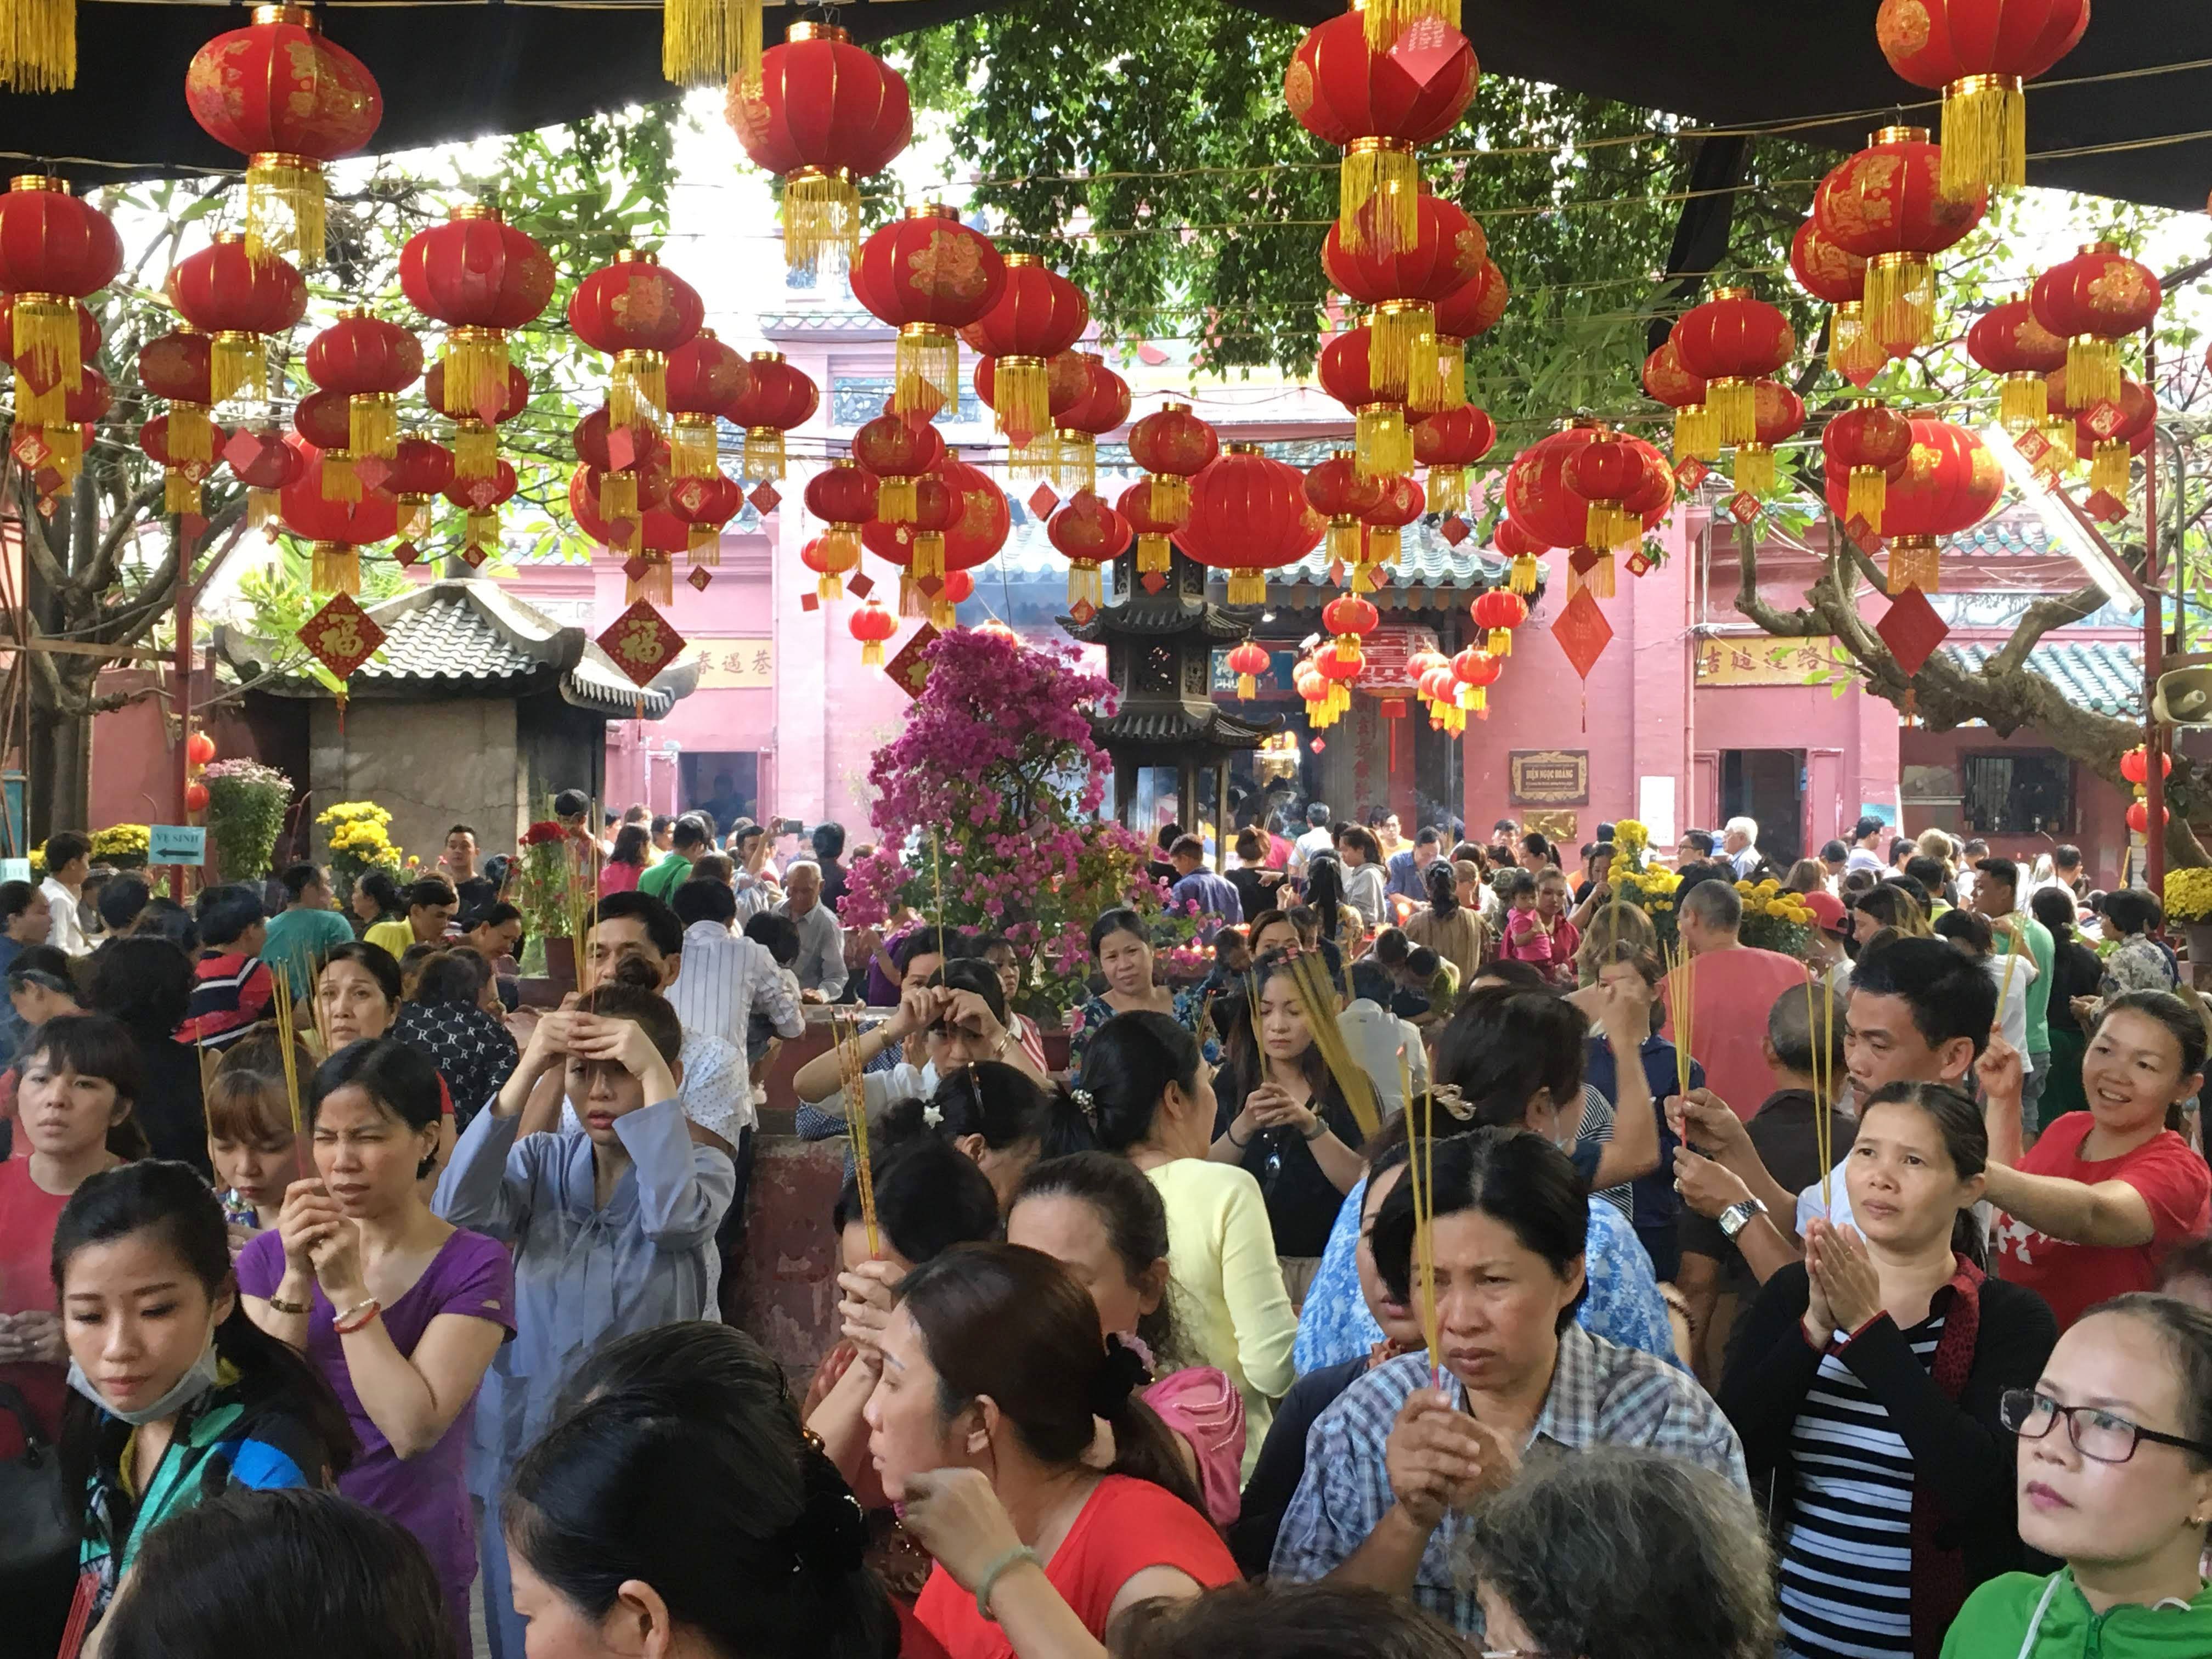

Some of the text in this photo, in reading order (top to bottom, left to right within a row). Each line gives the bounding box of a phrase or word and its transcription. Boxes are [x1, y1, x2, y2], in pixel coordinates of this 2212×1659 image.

[319, 613, 364, 657] 福
[619, 619, 664, 664] 福
[173, 834, 198, 843] SINH
[422, 1008, 433, 1018] R
[454, 1012, 464, 1023] R
[406, 1019, 414, 1028] R
[417, 1029, 428, 1041] R
[467, 1026, 476, 1036] R
[447, 1034, 457, 1045] R
[432, 1043, 439, 1053] R
[476, 1042, 484, 1054] R
[461, 1049, 469, 1059] R
[441, 1058, 451, 1070] R
[456, 1074, 464, 1084] R
